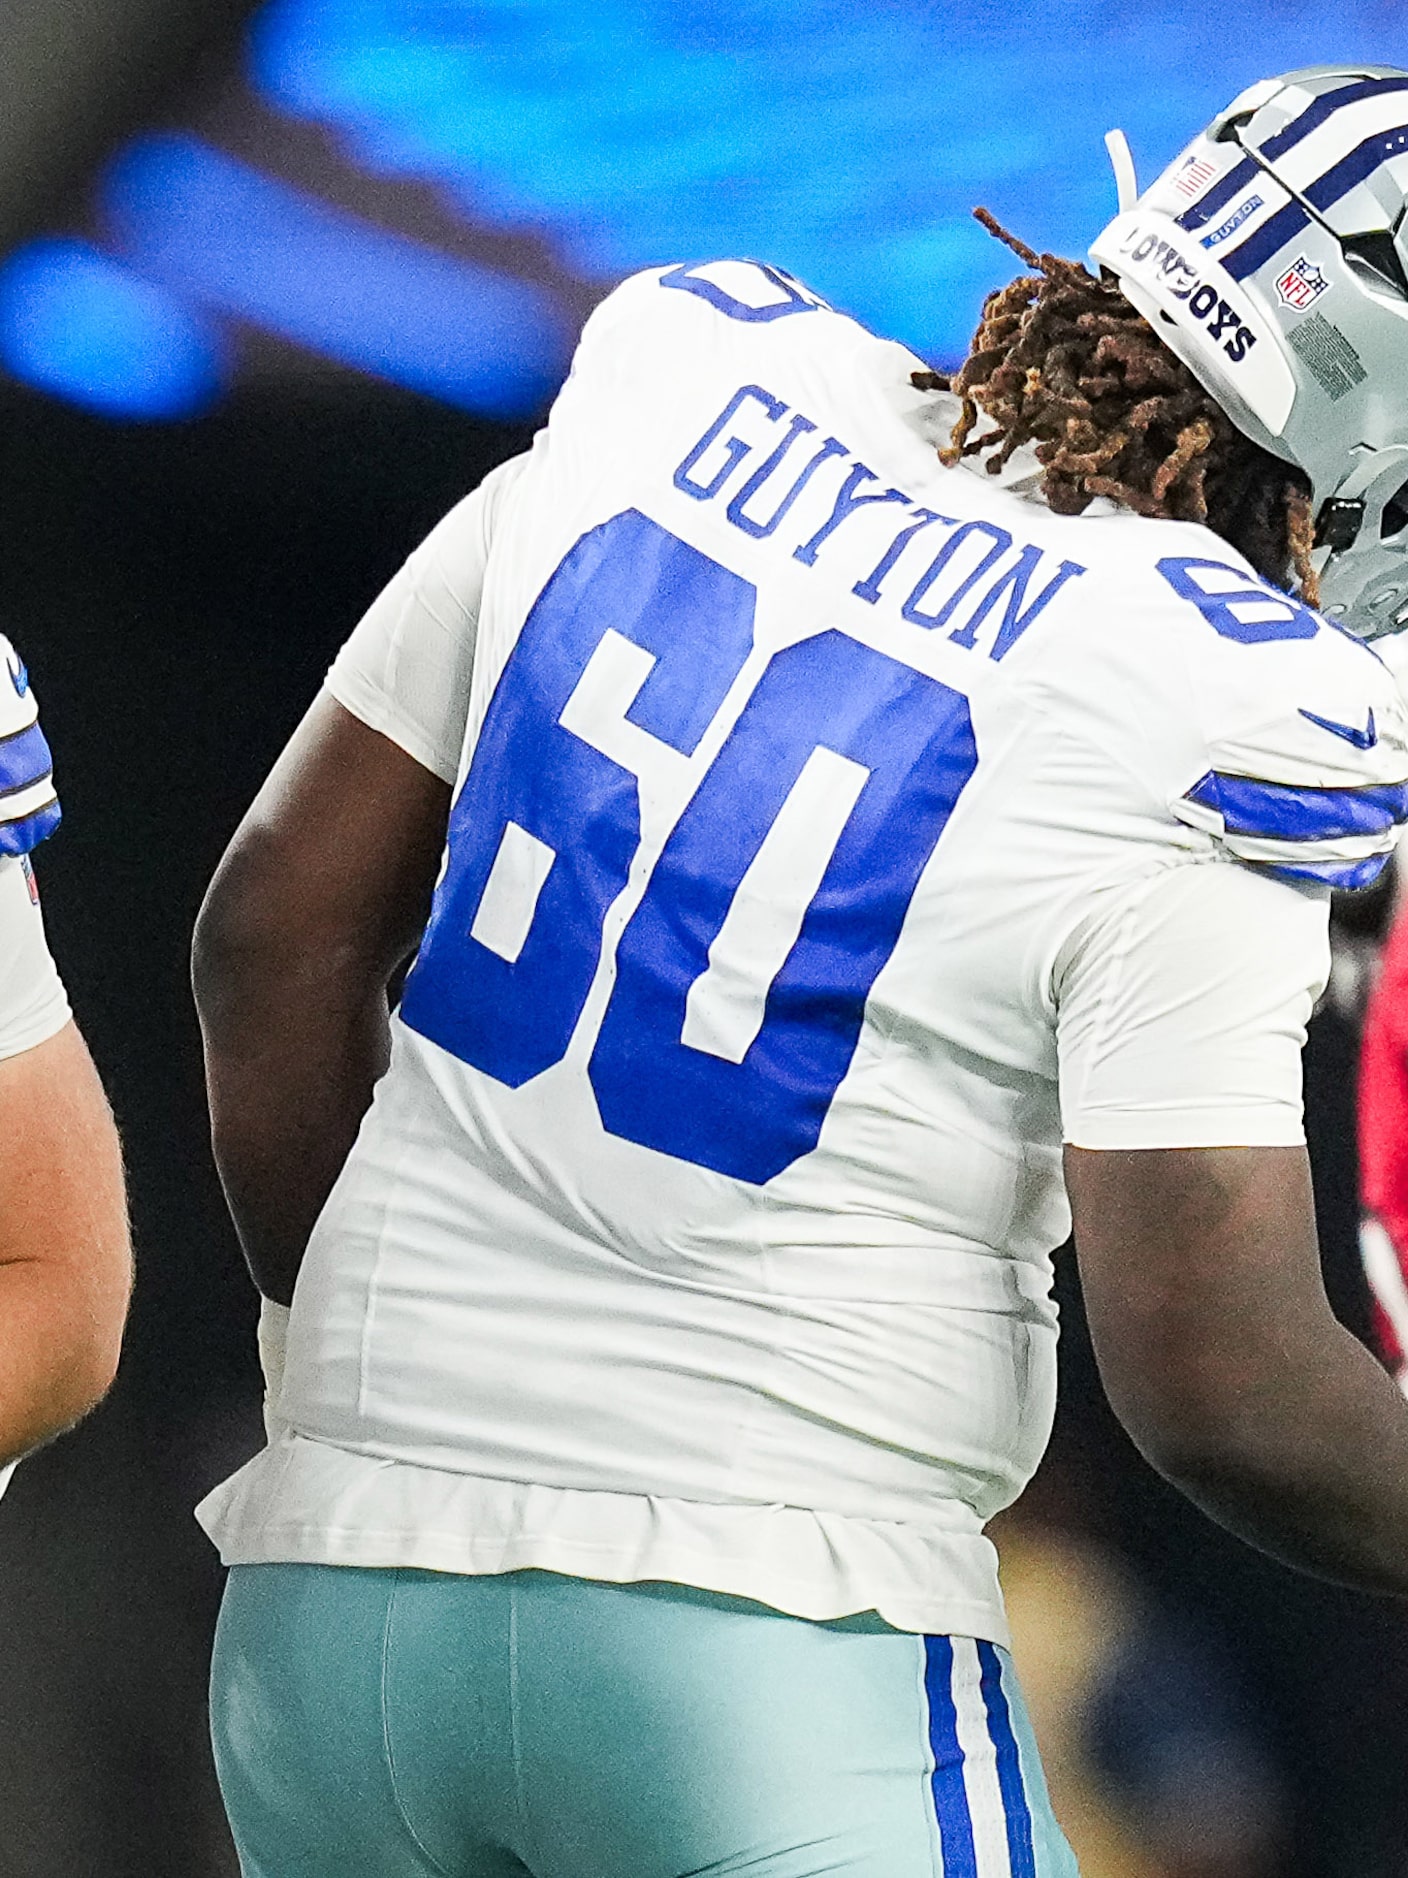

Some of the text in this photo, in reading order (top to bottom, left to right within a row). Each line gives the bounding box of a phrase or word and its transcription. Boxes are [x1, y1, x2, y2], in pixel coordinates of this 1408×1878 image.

[1279, 272, 1311, 306] NFL
[673, 385, 1086, 662] GUYTON
[400, 508, 980, 1187] 60
